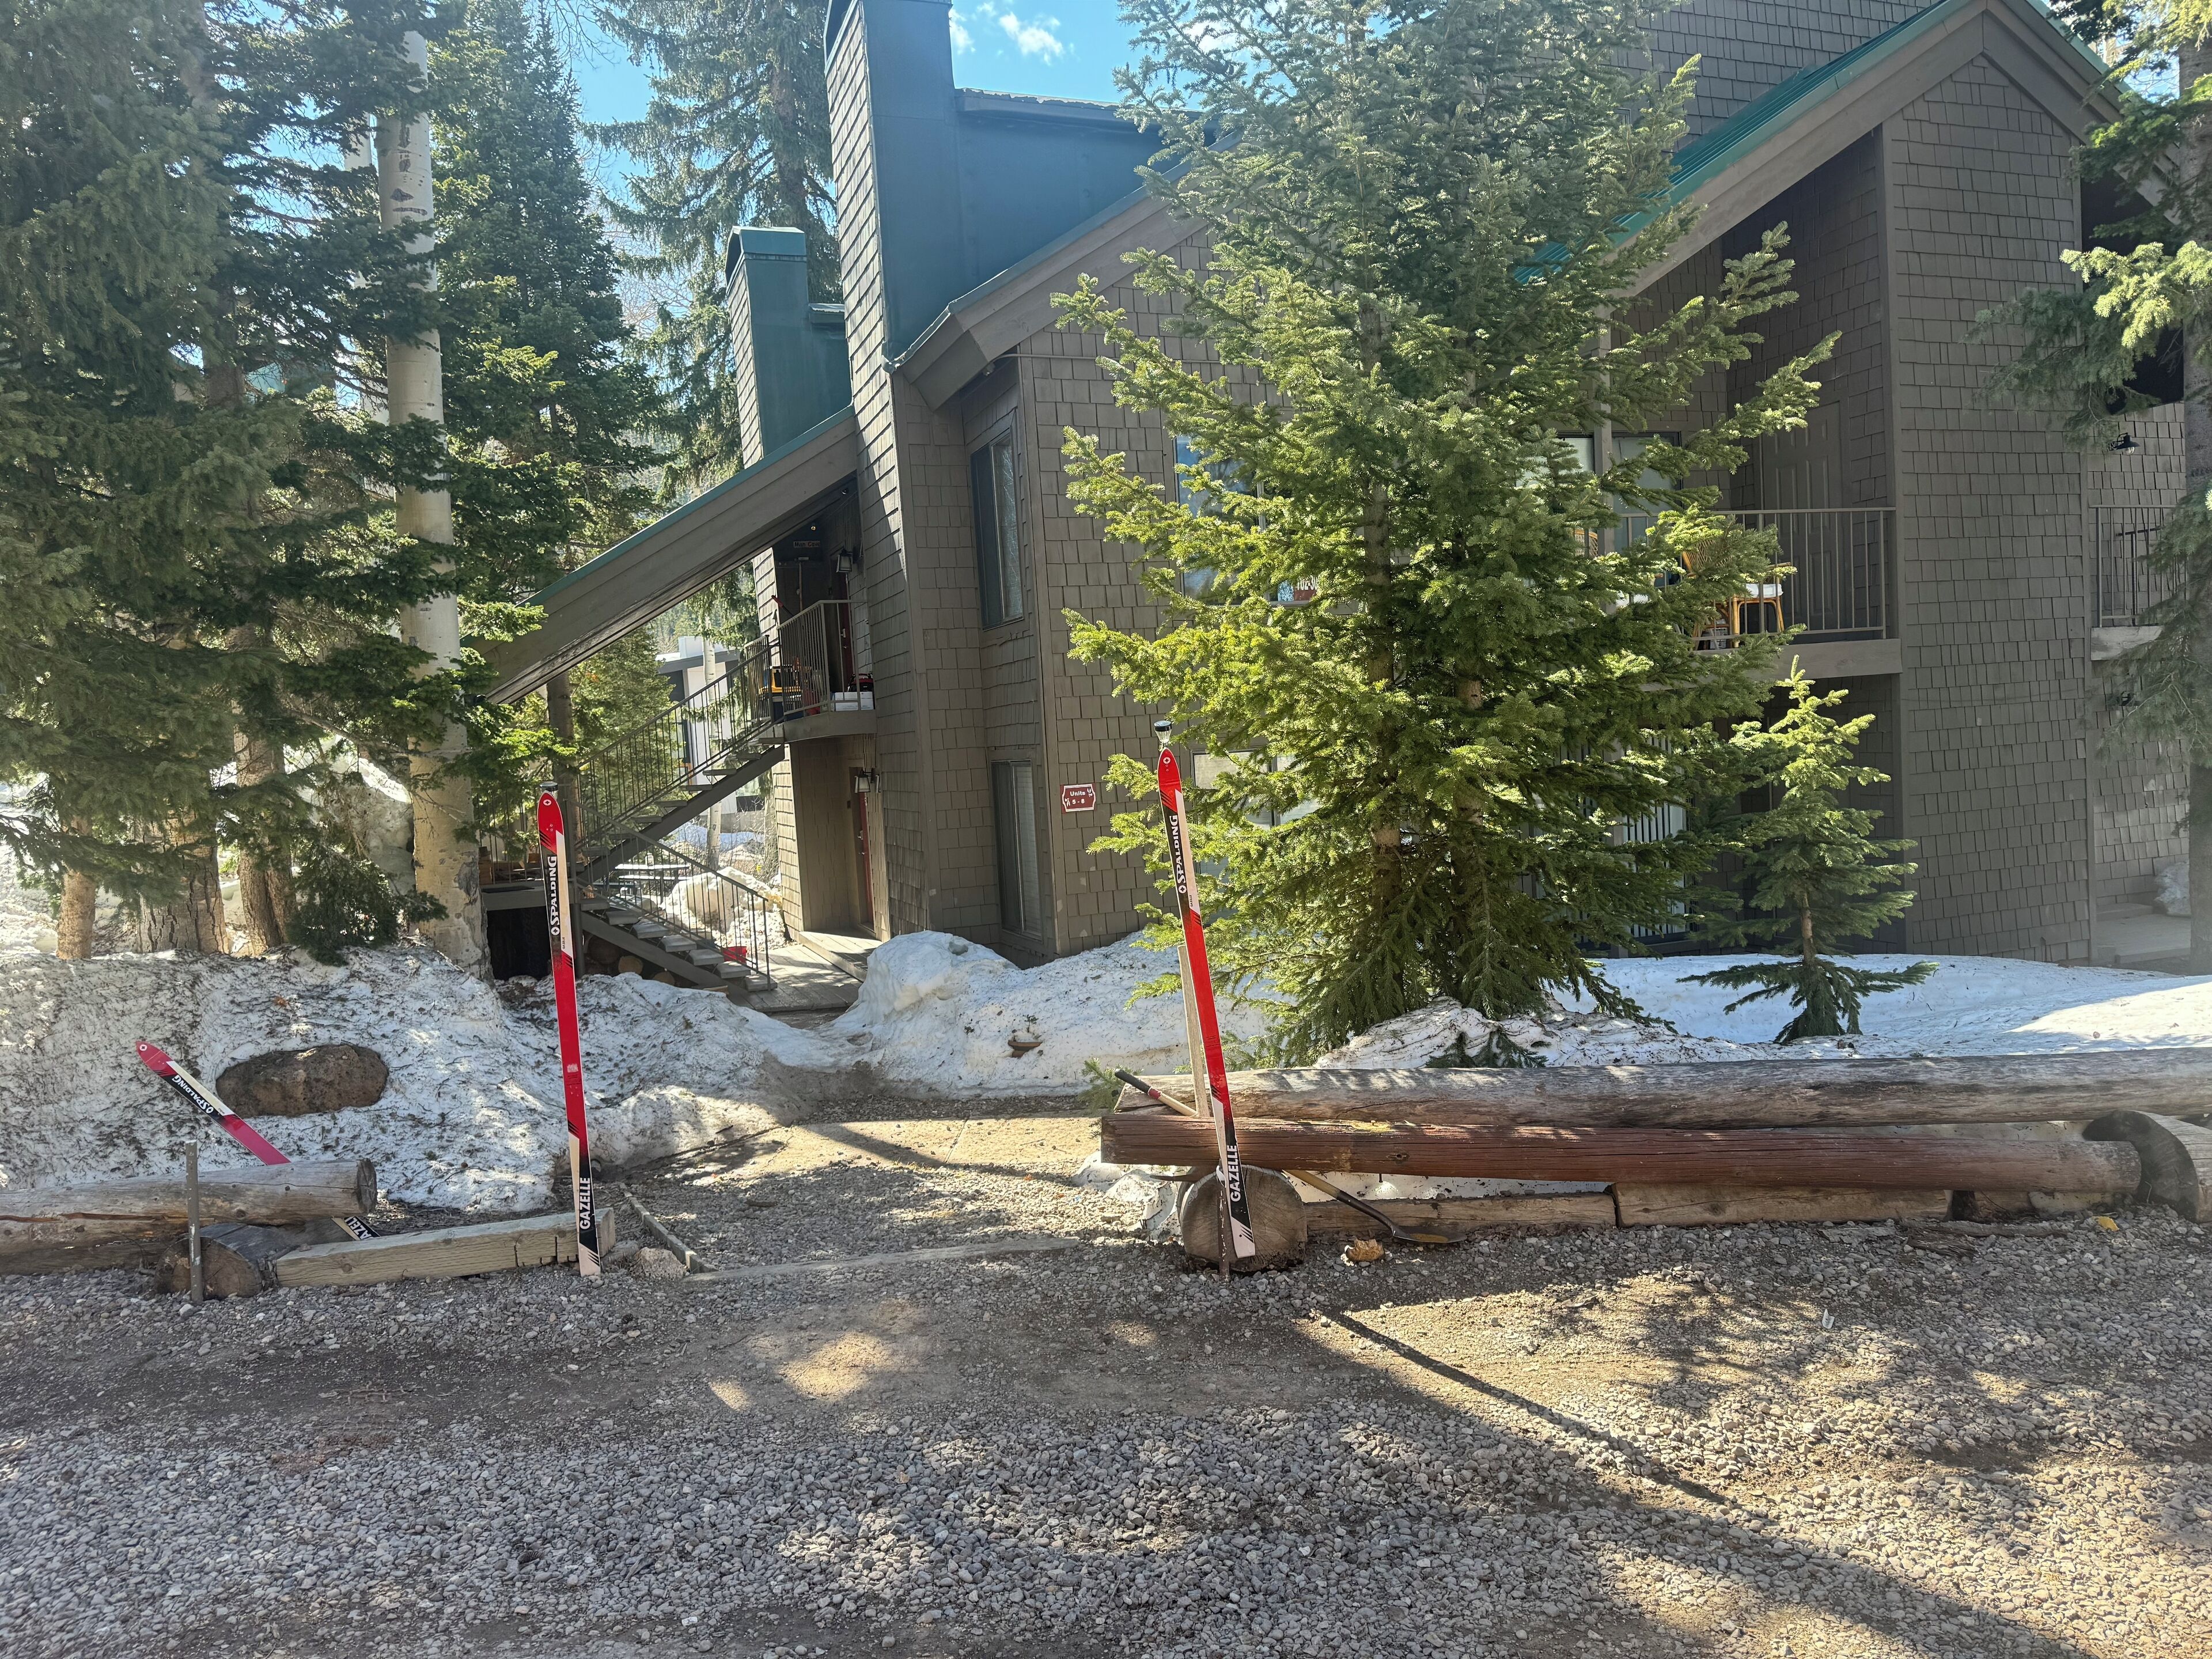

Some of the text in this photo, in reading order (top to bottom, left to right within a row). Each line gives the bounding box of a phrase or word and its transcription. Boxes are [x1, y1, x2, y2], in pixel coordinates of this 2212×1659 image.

[1169, 815, 1186, 884] SPALDING
[547, 856, 560, 926] SPALDING
[172, 1074, 210, 1110] SPALDING
[1226, 1145, 1241, 1202] GAZELLE
[344, 1217, 373, 1240] AZEL
[579, 1177, 591, 1230] GAZELLE
